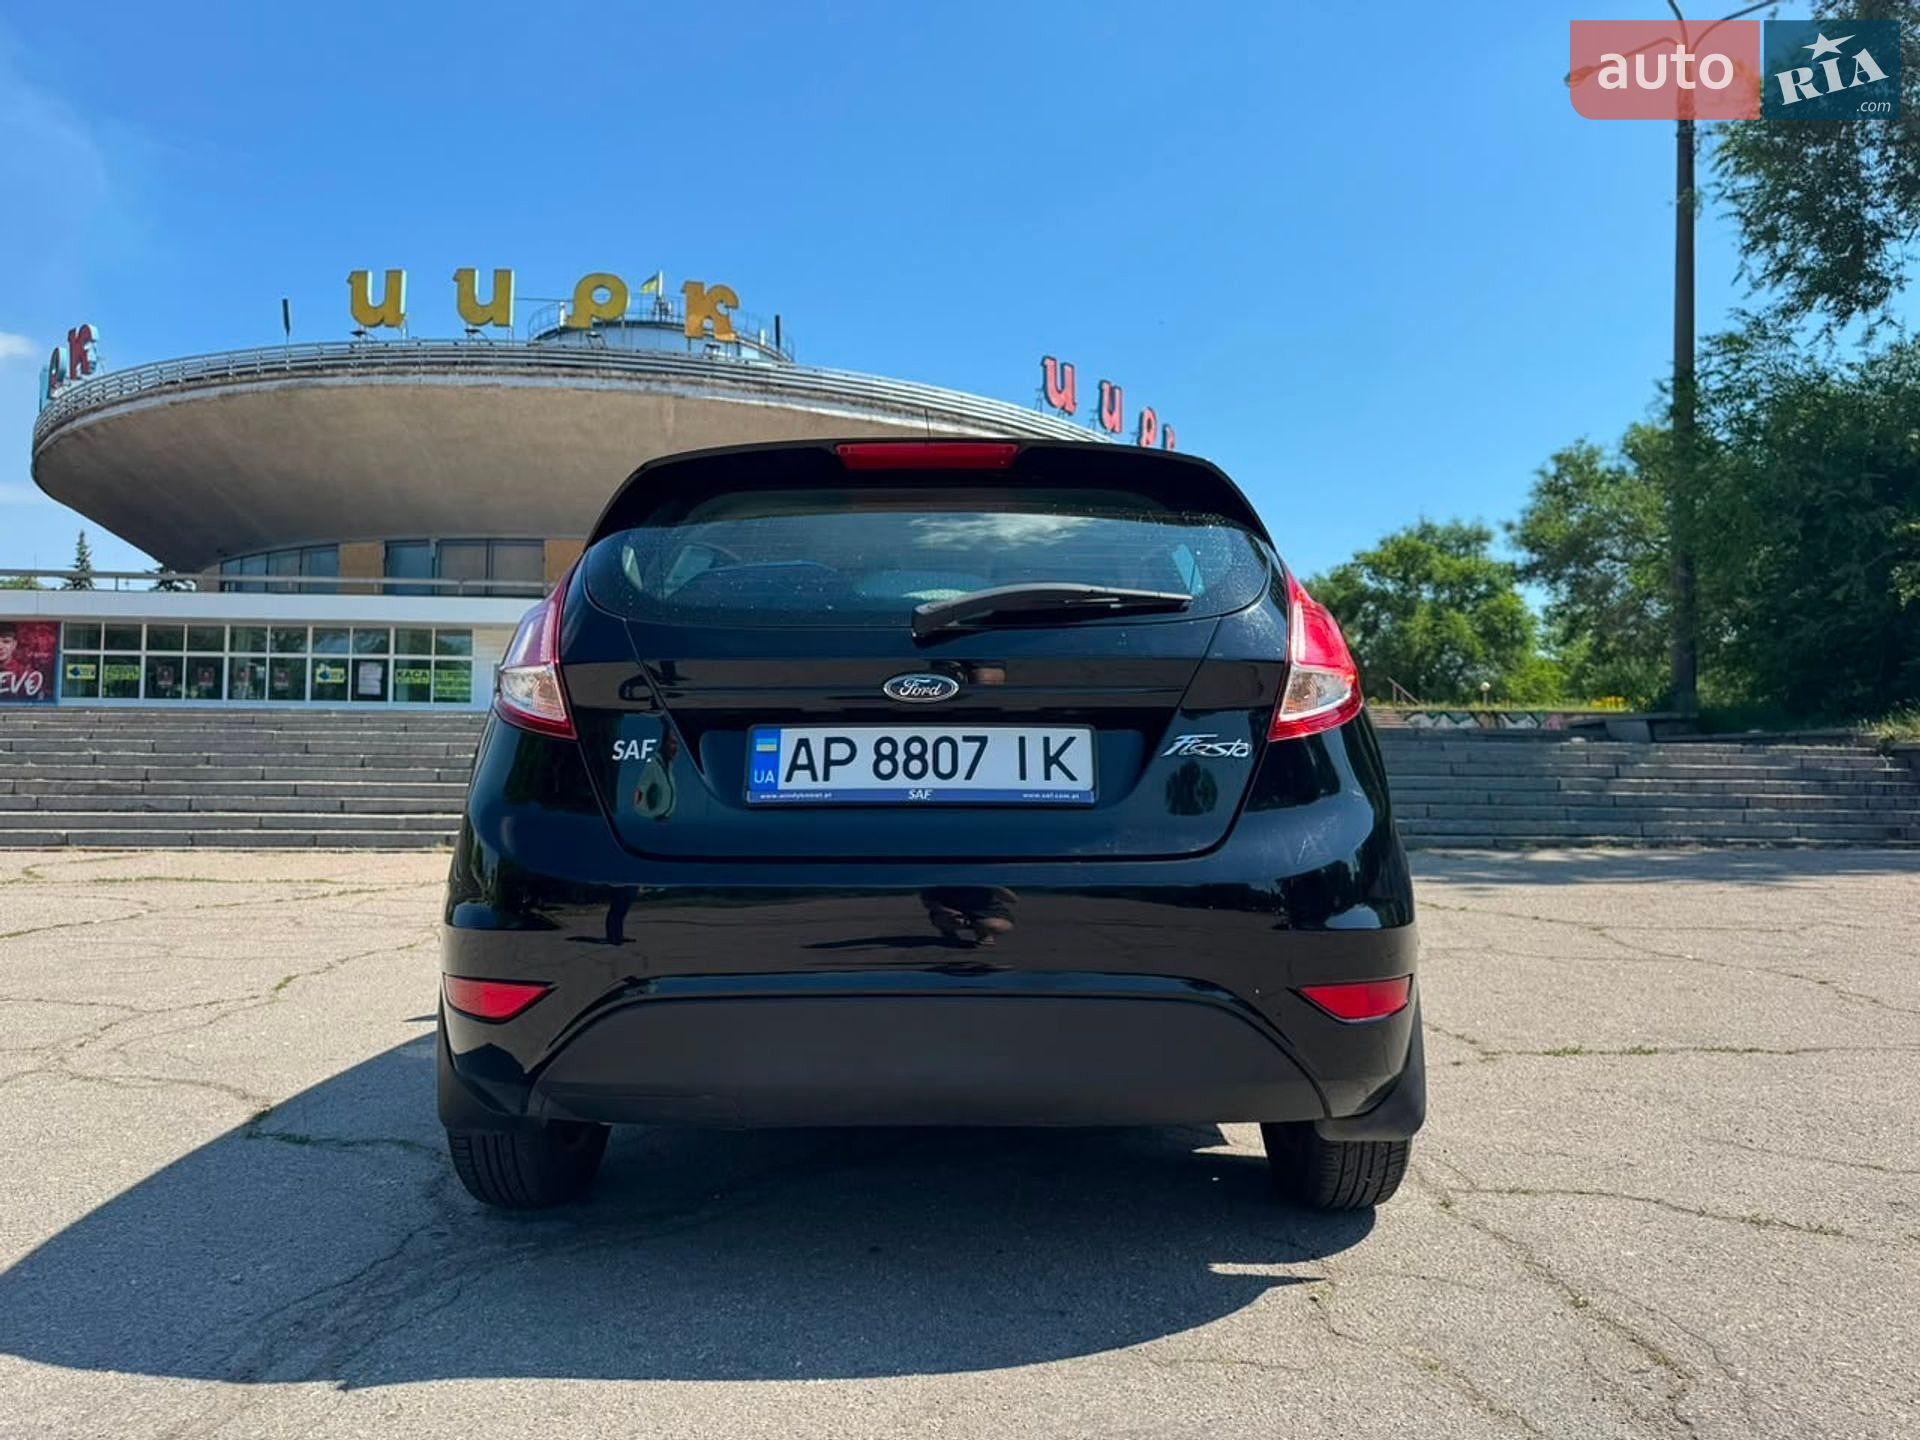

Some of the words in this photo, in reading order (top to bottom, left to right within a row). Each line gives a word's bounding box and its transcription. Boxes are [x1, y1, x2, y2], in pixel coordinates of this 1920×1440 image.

[898, 679, 942, 696] Ford
[1160, 734, 1251, 758] Fiesta
[783, 736, 857, 783] AP
[873, 735, 988, 782] 8807
[1018, 735, 1078, 782] IK
[753, 770, 775, 785] UA
